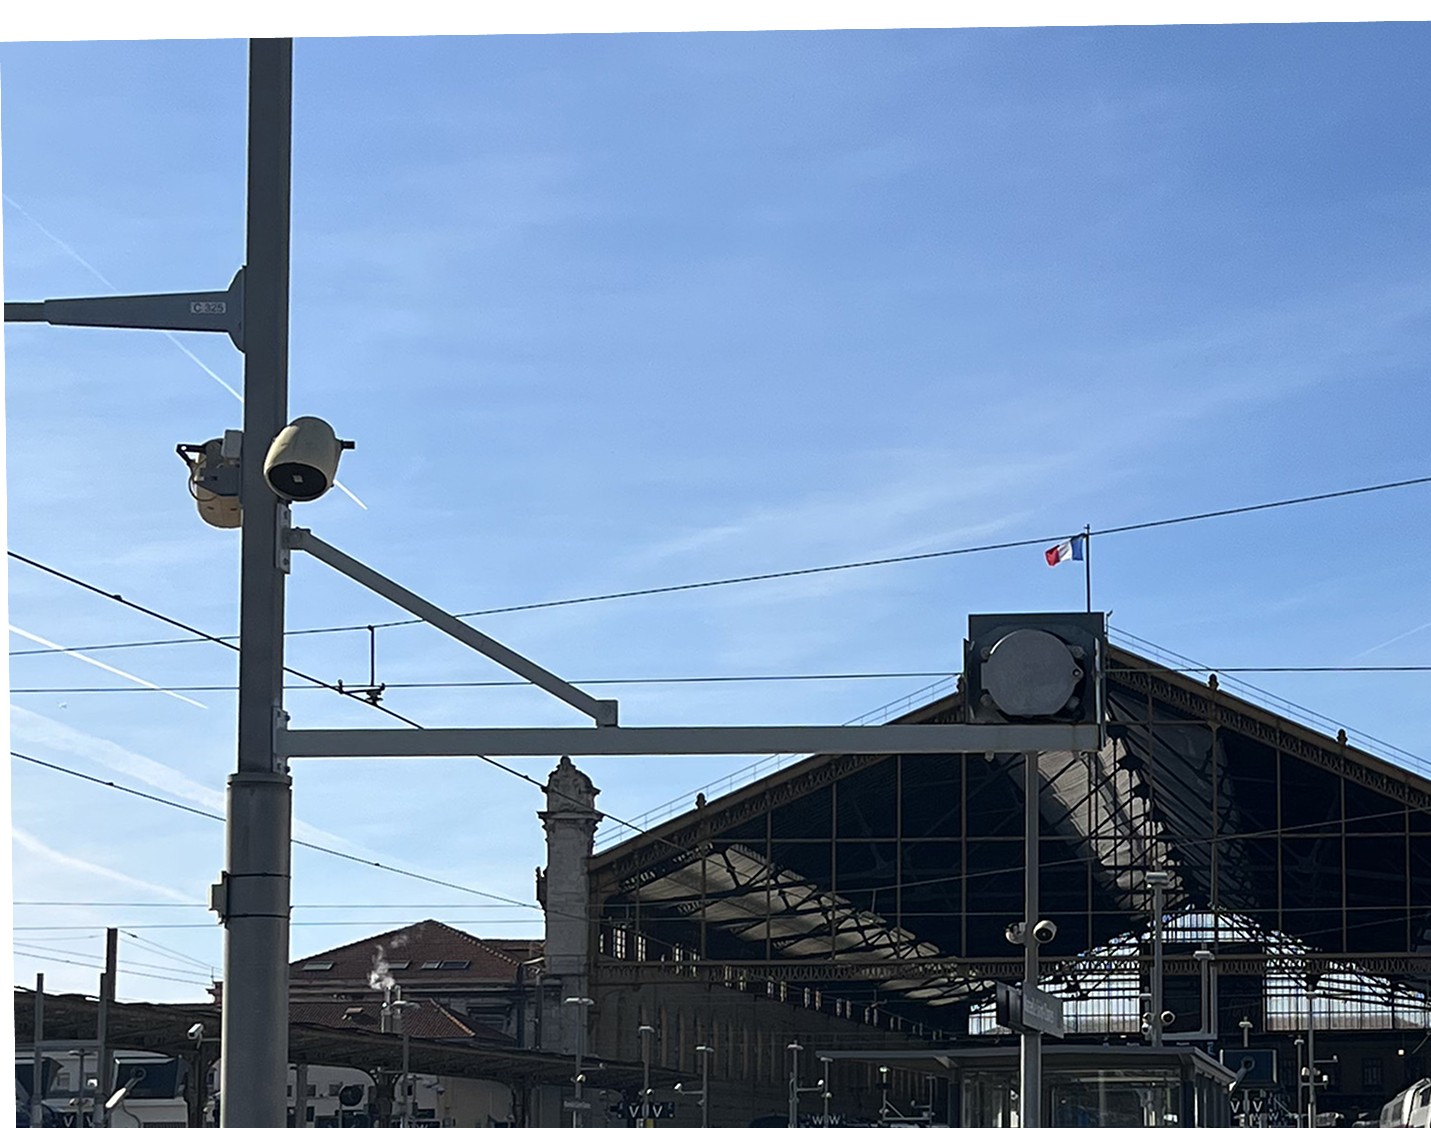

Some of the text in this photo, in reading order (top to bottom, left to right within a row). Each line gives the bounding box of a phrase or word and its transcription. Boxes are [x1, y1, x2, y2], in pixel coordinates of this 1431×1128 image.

[193, 303, 225, 313] C 325
[629, 1105, 663, 1118] V V
[1252, 1101, 1262, 1112] V
[63, 1116, 74, 1127] V
[812, 1115, 841, 1125] W W
